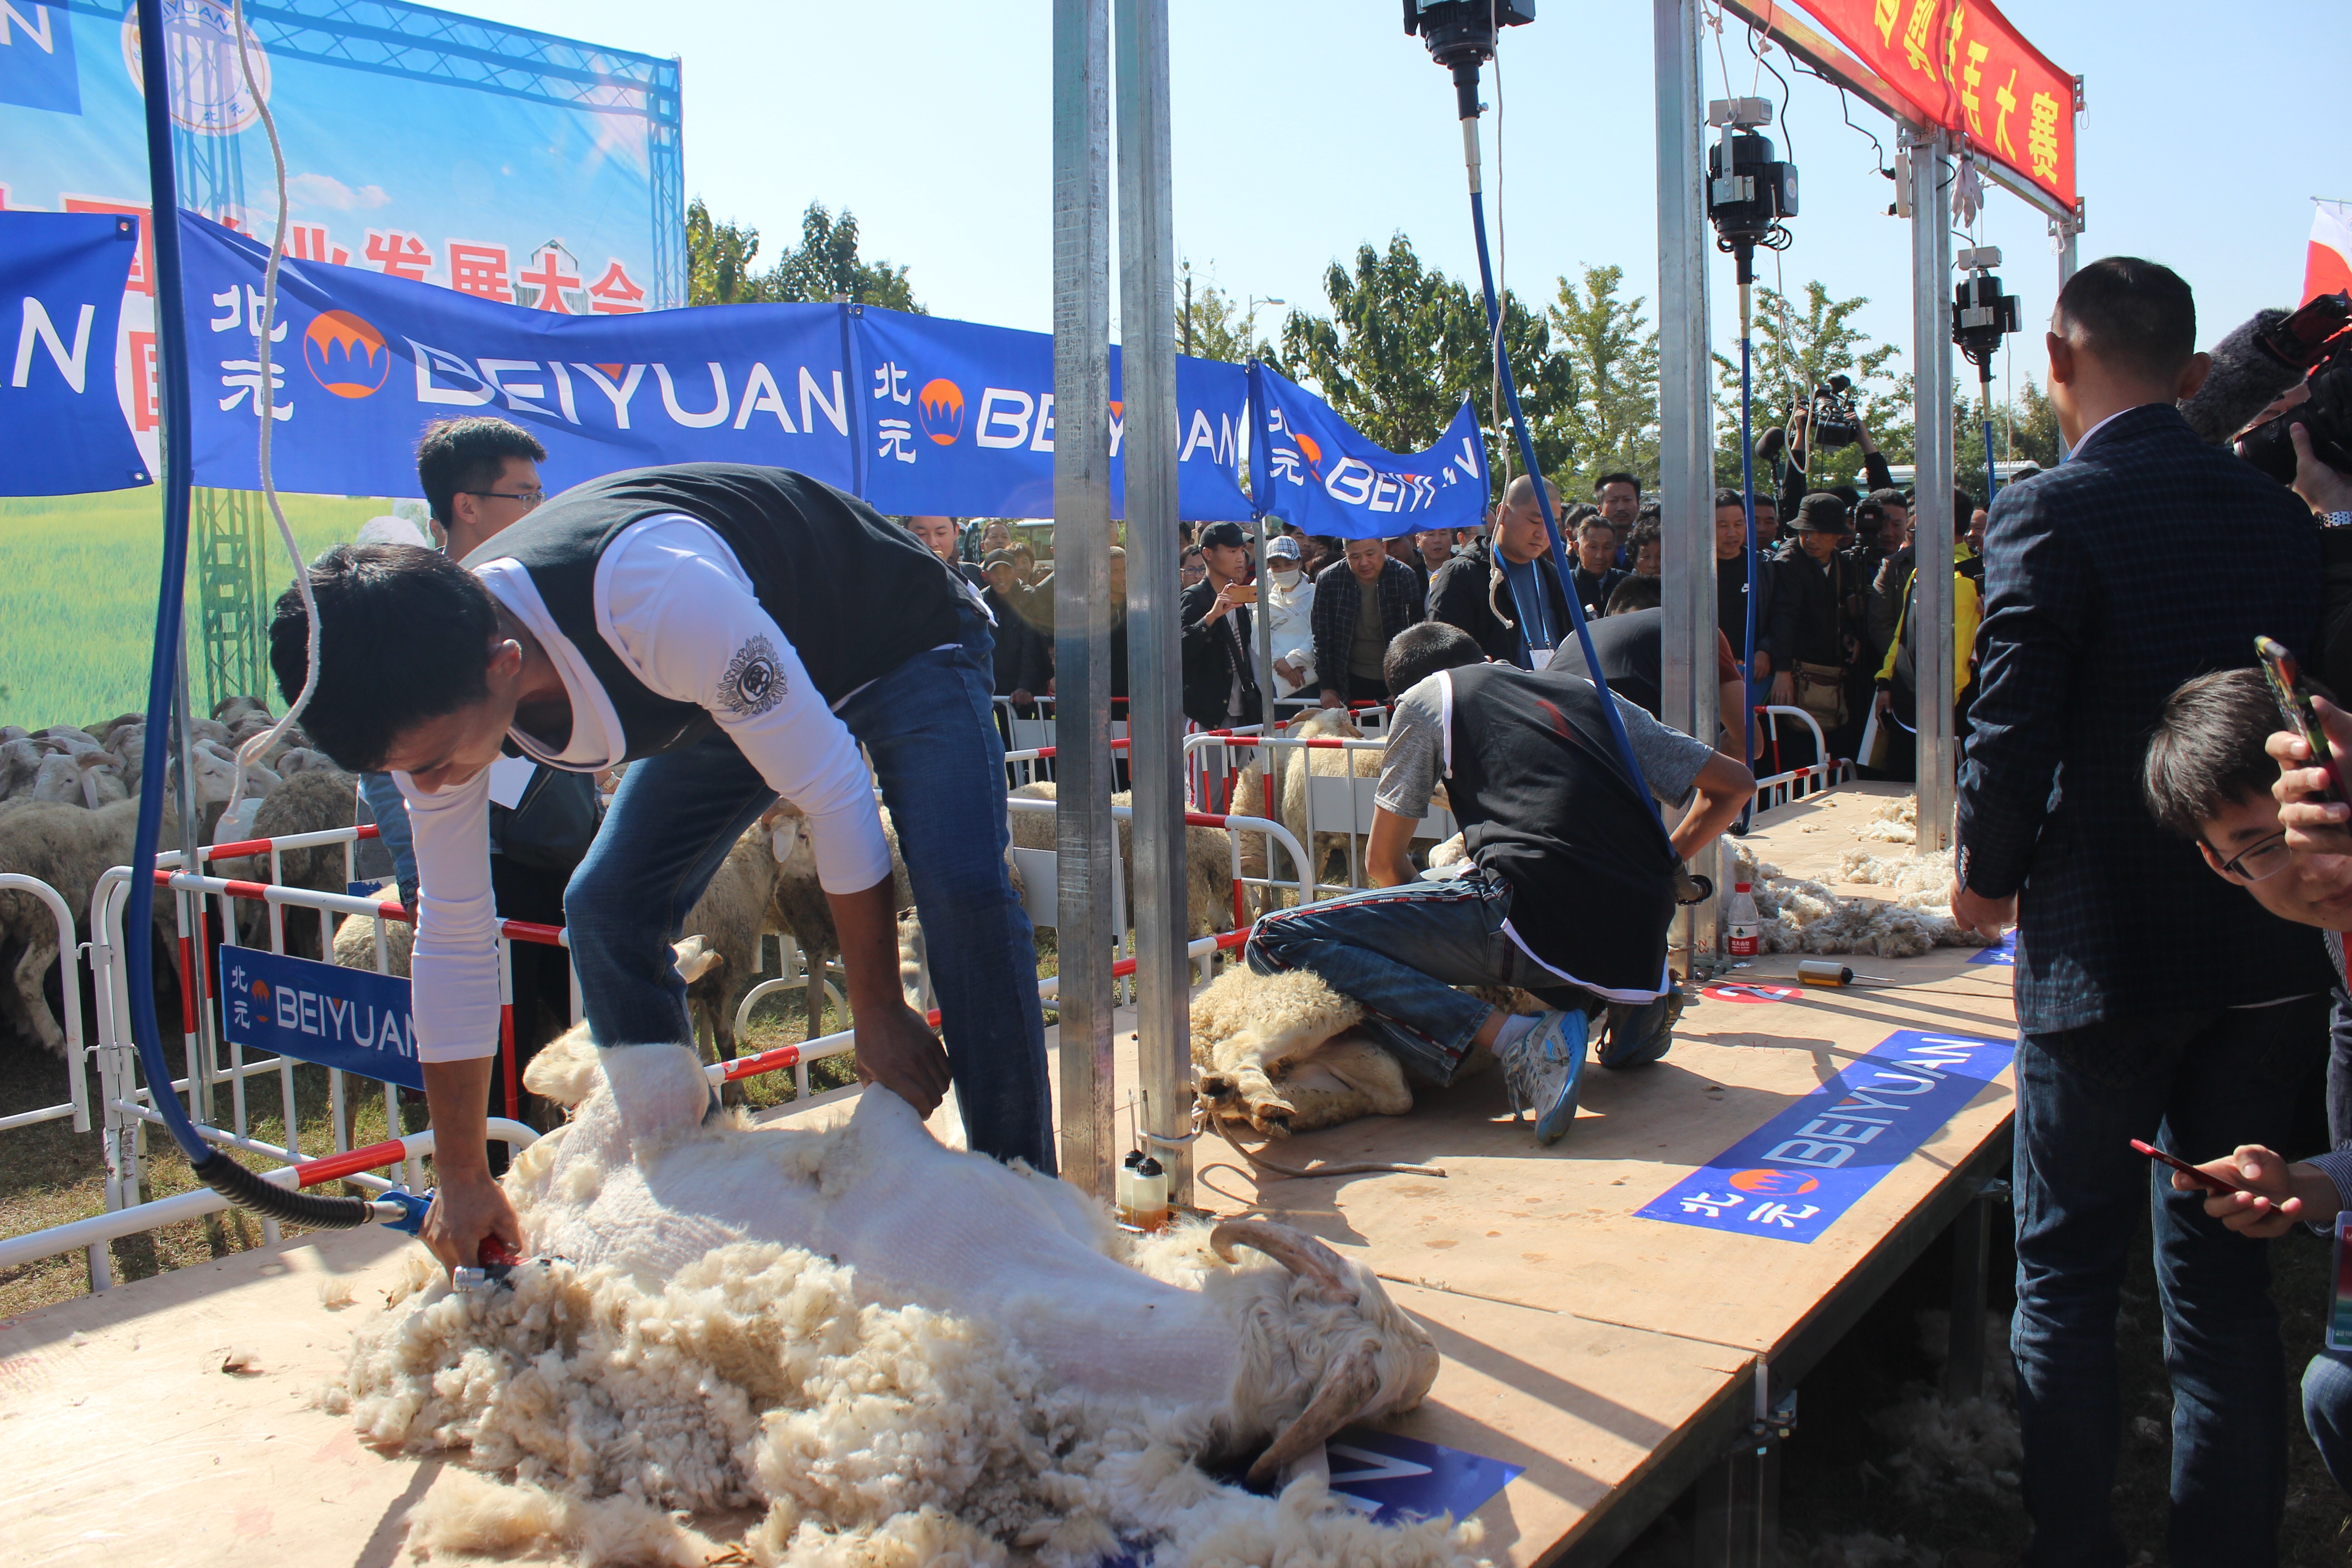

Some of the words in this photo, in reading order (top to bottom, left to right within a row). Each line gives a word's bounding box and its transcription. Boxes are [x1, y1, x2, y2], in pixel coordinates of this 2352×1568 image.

[211, 284, 294, 421] 北元
[402, 335, 849, 436] BEIYUAN
[874, 361, 916, 464] 北元
[232, 965, 250, 1029] 北元
[1761, 1037, 1985, 1169] BEIYUAN
[1679, 1191, 1820, 1228] 北元
